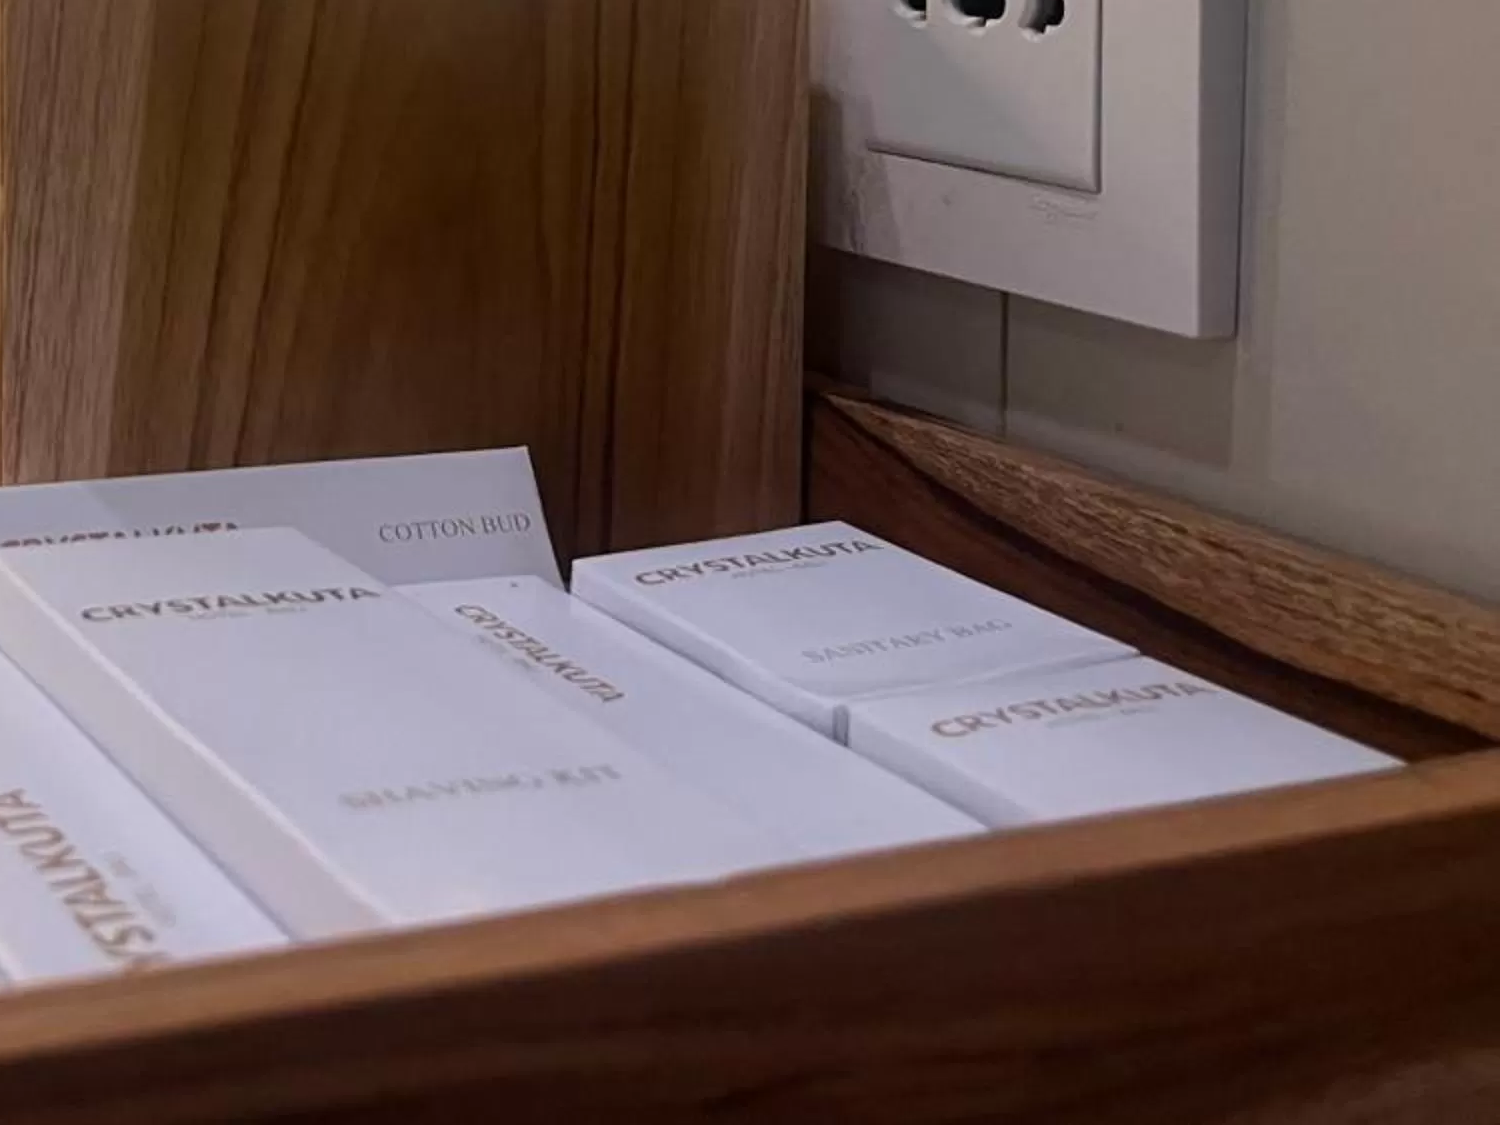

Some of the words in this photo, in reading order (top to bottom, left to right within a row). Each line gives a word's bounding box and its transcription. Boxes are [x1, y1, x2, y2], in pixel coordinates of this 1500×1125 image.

[379, 518, 476, 543] COTTON
[480, 513, 532, 535] BUD
[634, 539, 881, 588] CRYSTALKUTA
[80, 586, 381, 623] CRYSTALKUTA
[453, 604, 626, 704] CRYSTALKUTA
[930, 681, 1219, 740] CRYSTALKUTA
